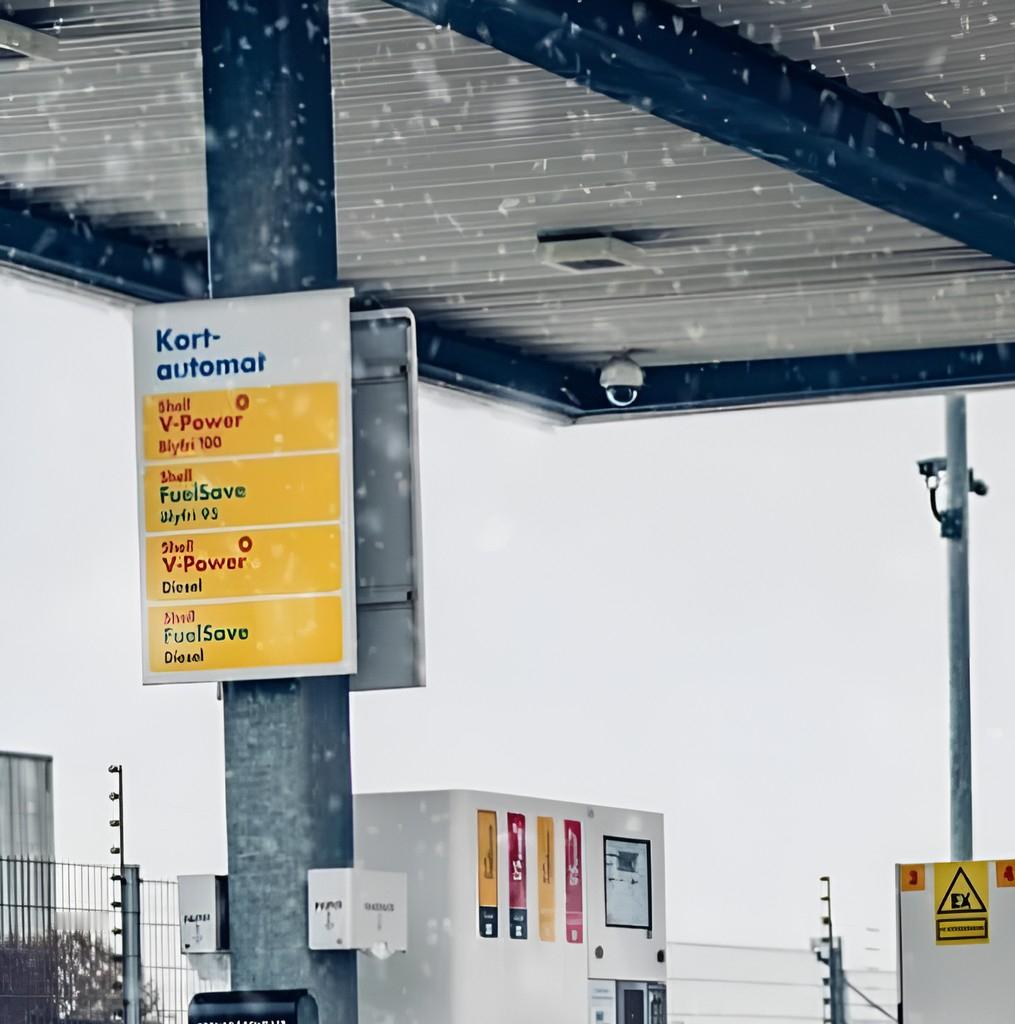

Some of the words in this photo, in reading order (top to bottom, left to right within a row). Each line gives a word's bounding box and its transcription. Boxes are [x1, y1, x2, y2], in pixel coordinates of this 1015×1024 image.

[157, 328, 221, 352] Kort-
[157, 351, 267, 381] automat
[159, 414, 244, 432] V-Power
[160, 482, 247, 504] FuelSave
[162, 555, 247, 573] V-Power
